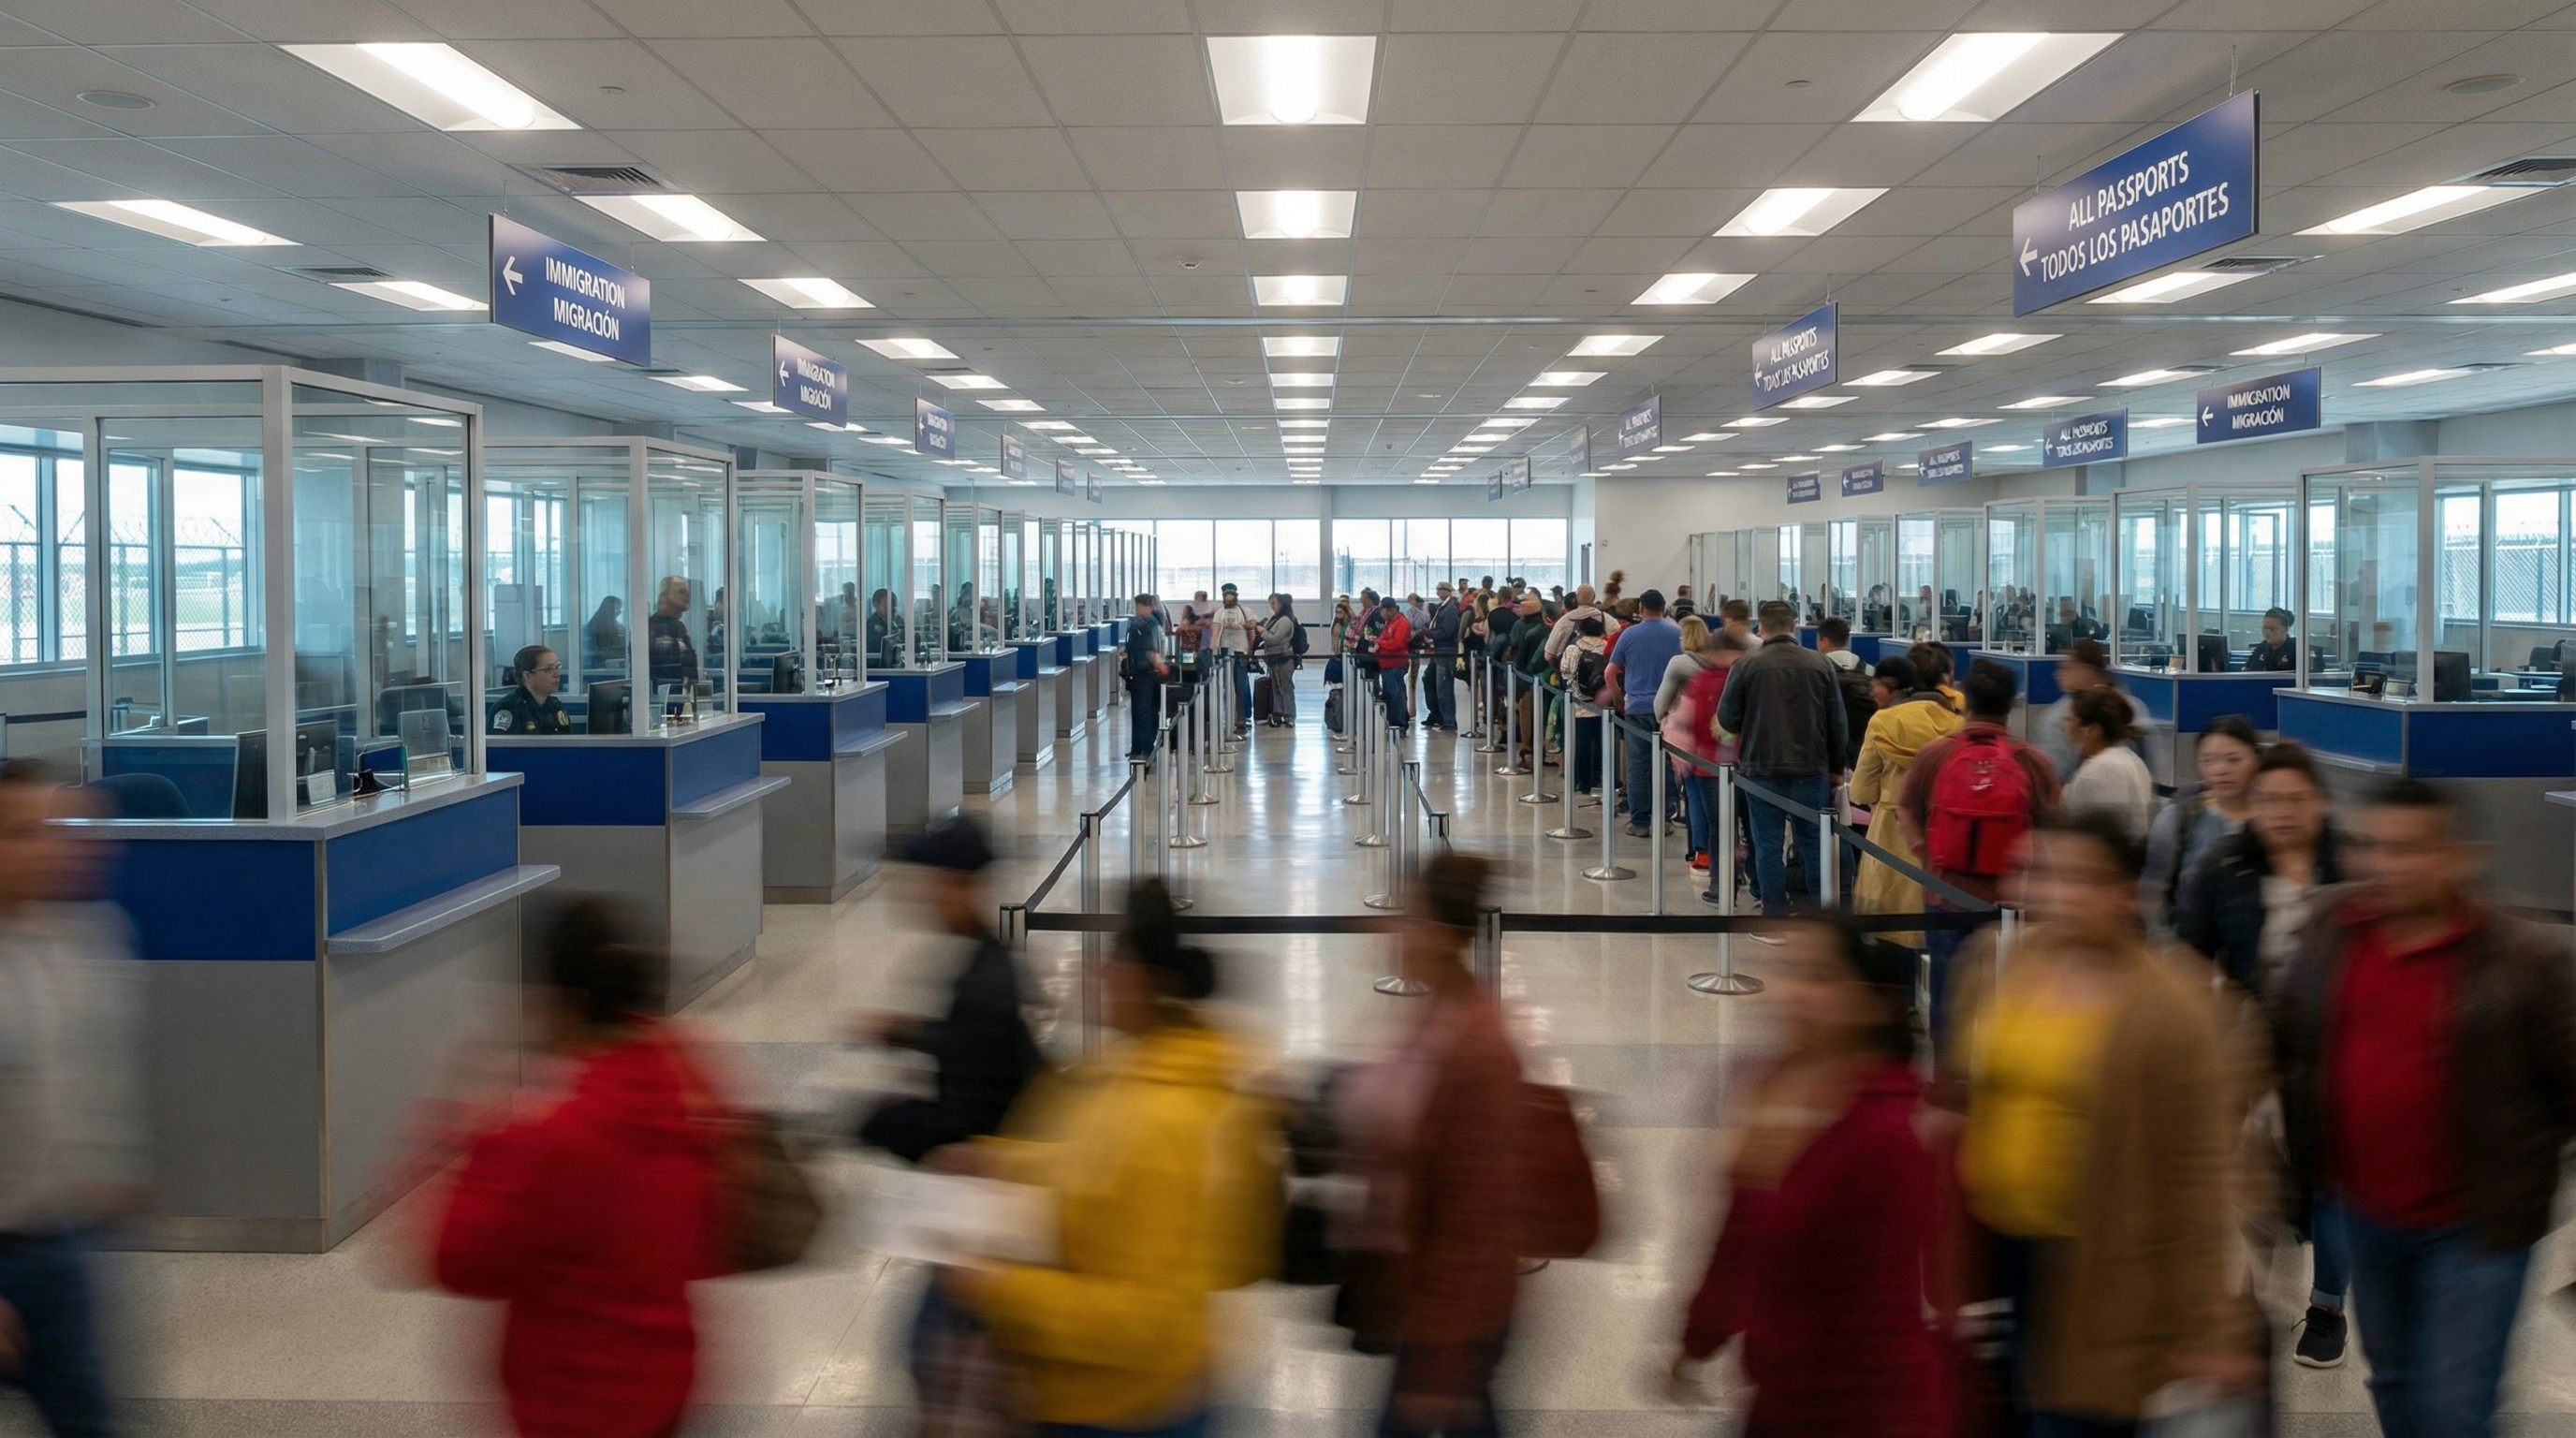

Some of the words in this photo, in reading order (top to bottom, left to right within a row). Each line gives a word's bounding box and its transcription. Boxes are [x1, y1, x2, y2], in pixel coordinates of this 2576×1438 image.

[2068, 196, 2094, 231] ALL
[2098, 151, 2189, 219] PASSPORTS
[2041, 241, 2086, 283] TODOS
[2090, 227, 2116, 265] LOS
[2121, 182, 2230, 253] PASAPORTES
[546, 257, 625, 309] IMMIGRATION
[554, 298, 620, 341] MIGRACIÓN
[2227, 384, 2291, 409] IMMIGRATION
